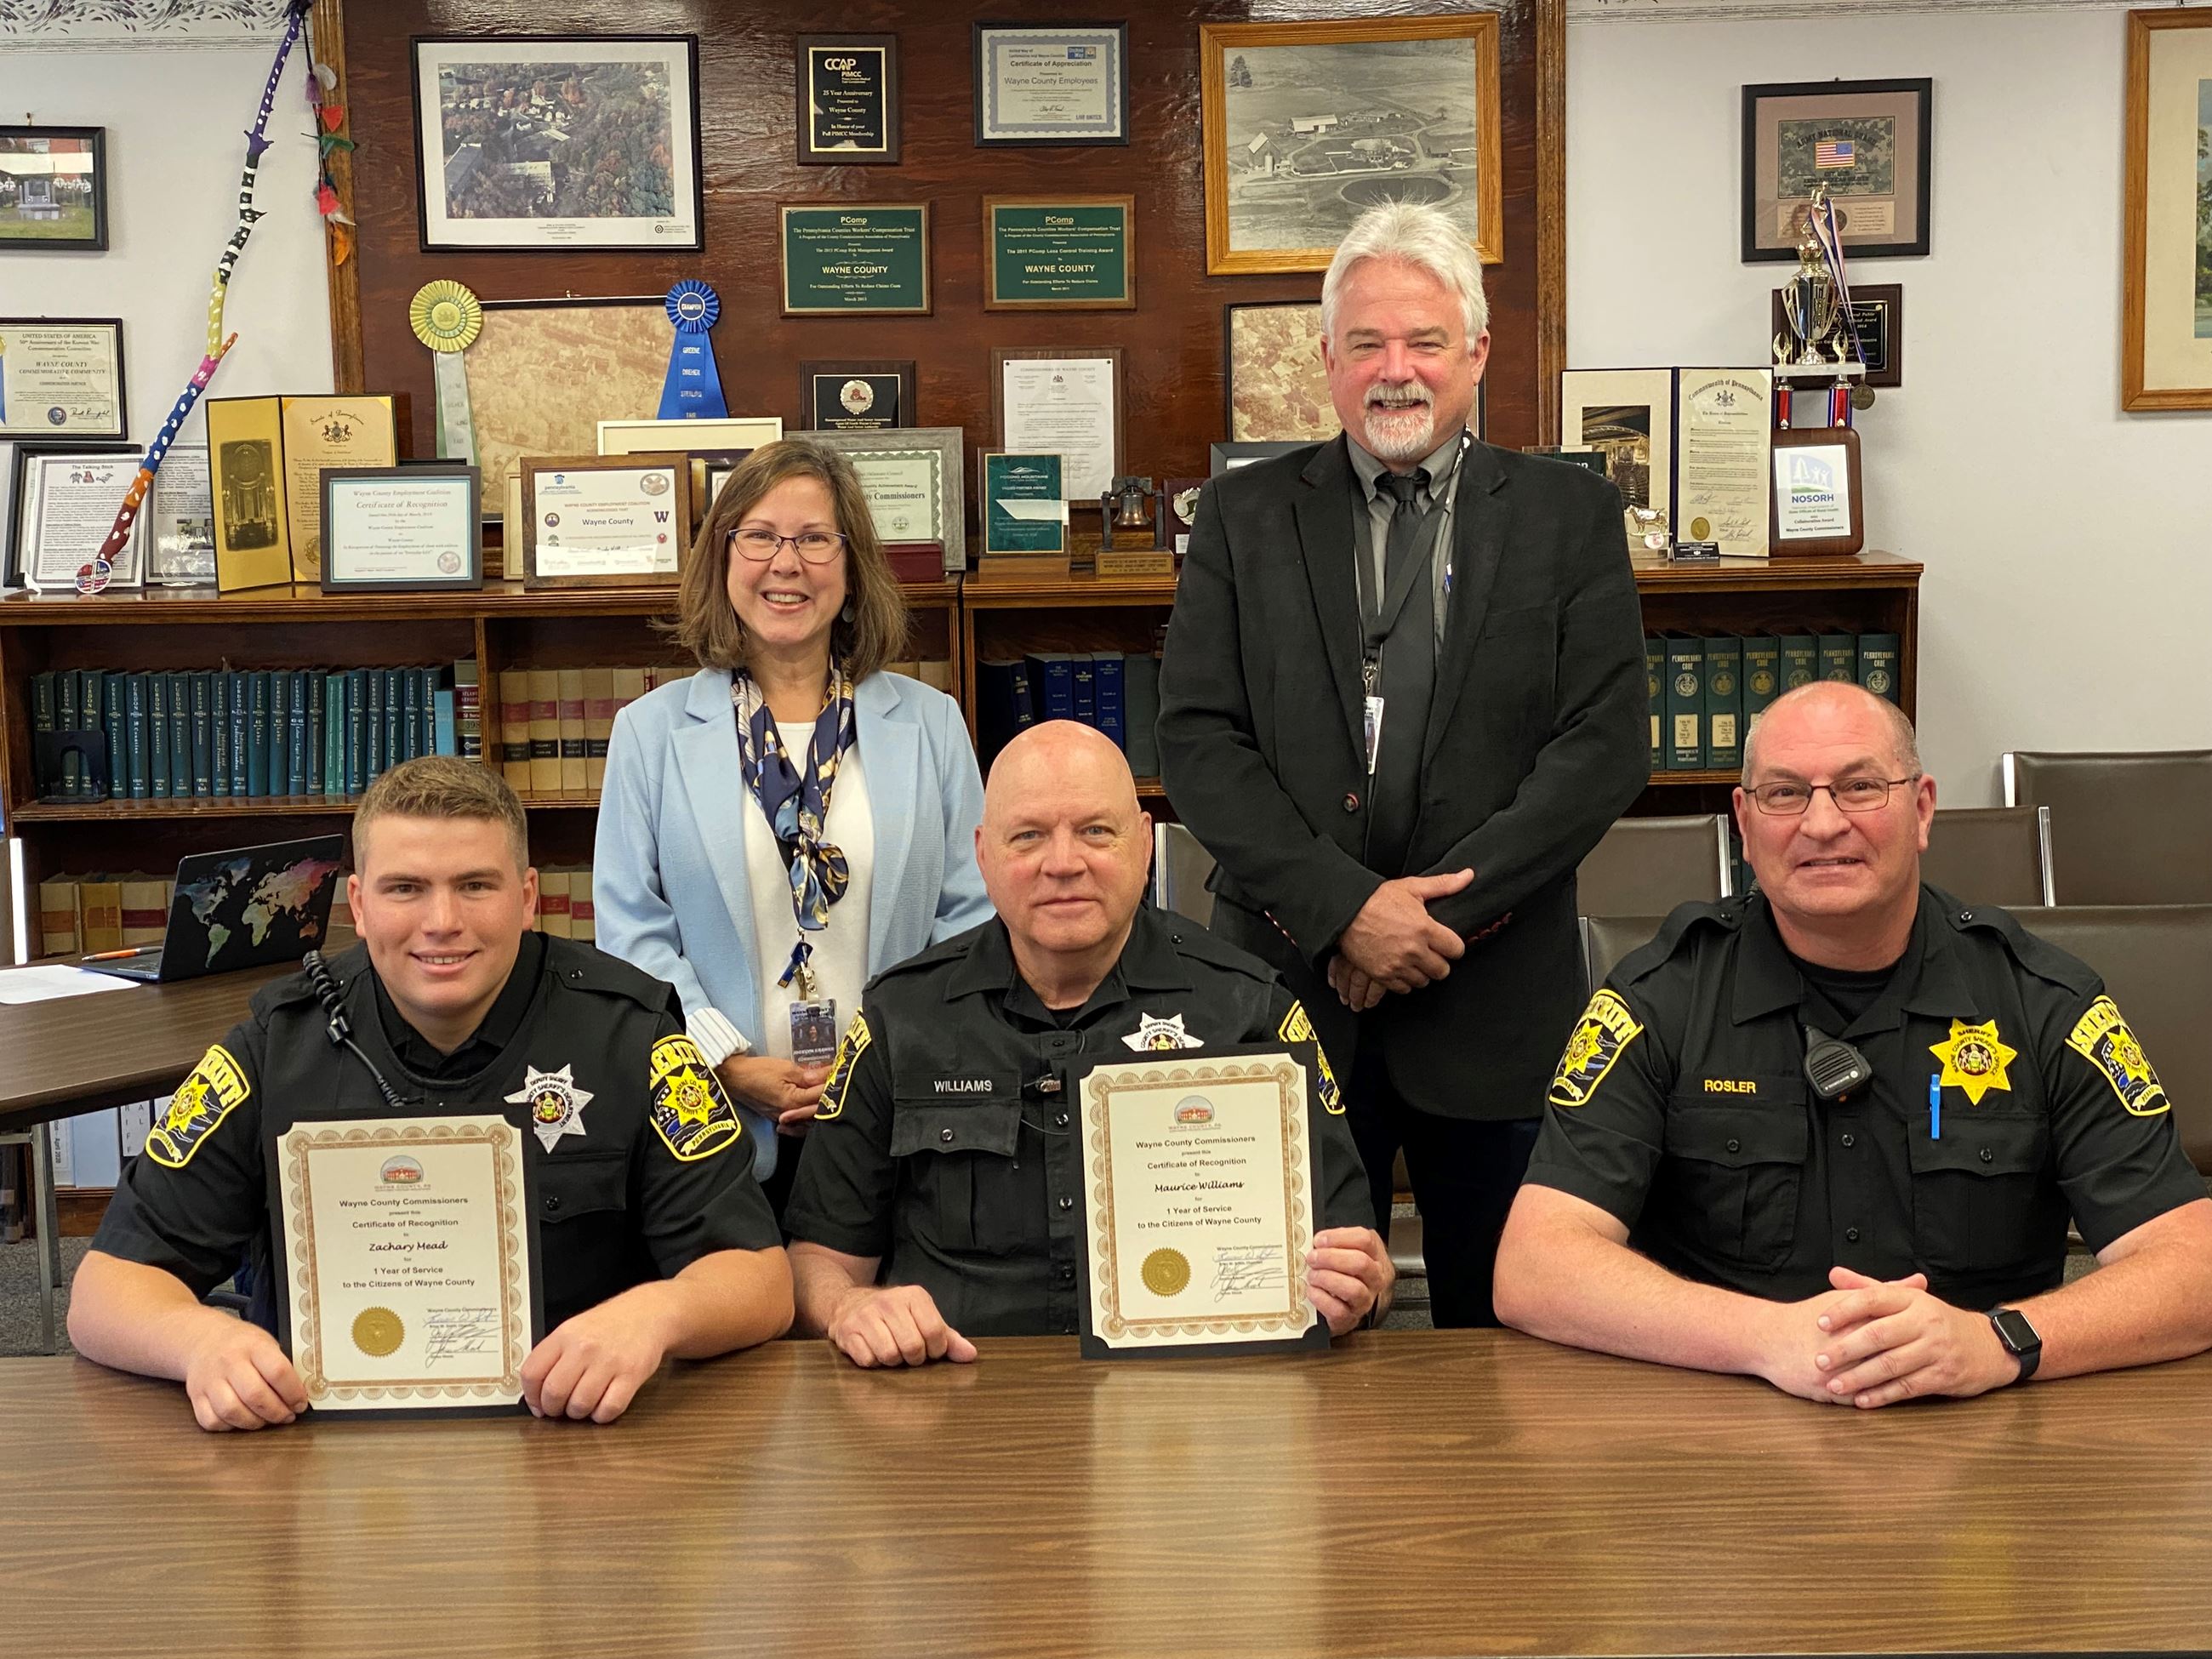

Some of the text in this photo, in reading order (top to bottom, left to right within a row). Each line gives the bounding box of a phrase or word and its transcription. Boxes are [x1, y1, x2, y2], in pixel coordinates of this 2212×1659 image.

[824, 58, 857, 71] CCAP
[1798, 133, 1816, 149] ARMY
[1818, 129, 1852, 140] NATIONAL
[1688, 379, 1724, 401] Commonwealth
[1731, 379, 1763, 402] Pennsylvania
[874, 492, 925, 500] Commissioners
[1792, 494, 1834, 503] NOSORH
[407, 500, 448, 509] Recognition
[654, 511, 670, 523] W
[1672, 654, 1702, 663] PENNSYLVANIA
[1863, 651, 1895, 659] PENNSYLVANIA
[1682, 662, 1693, 670] CODE
[1958, 1029, 1993, 1037] SHERIFF
[1953, 1037, 1971, 1051] COUNTY
[530, 1076, 548, 1086] DEPUTY
[934, 1080, 992, 1092] WILLIAMS
[1704, 1080, 1756, 1093] ROSLER
[692, 1122, 730, 1146] PENNSYLVANIA
[1136, 1141, 1162, 1149] Wayne
[1194, 1137, 1256, 1145] Commissioners
[1148, 1161, 1187, 1170] Certificate
[1200, 1159, 1246, 1167] Recognition
[1154, 1181, 1244, 1193] Maurice Williams
[402, 1197, 468, 1206] Commissioners
[1234, 1217, 1262, 1225] County
[369, 1240, 448, 1252] Zachary Mead
[415, 1280, 443, 1288] Wayne
